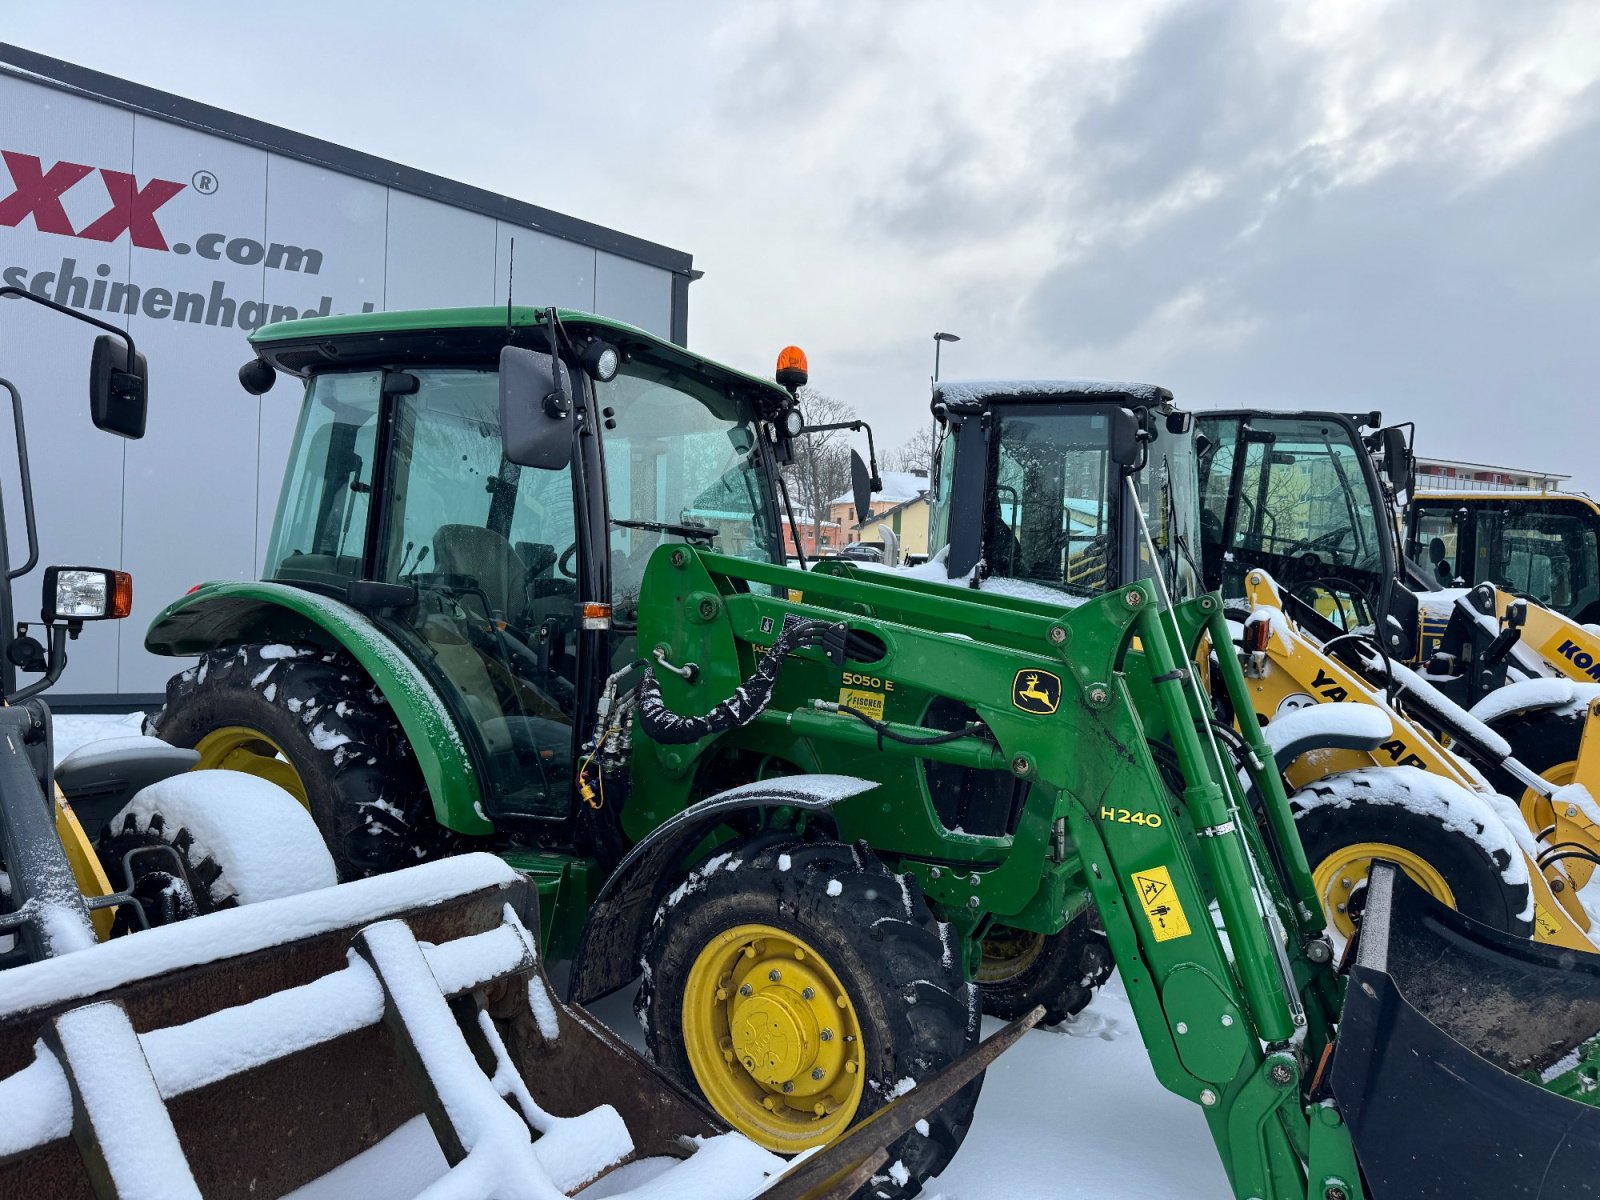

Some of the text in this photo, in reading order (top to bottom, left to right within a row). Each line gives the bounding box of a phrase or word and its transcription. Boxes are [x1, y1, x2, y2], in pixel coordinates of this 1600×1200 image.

[842, 672, 895, 691] 5050 E
[852, 696, 882, 709] FISCHER
